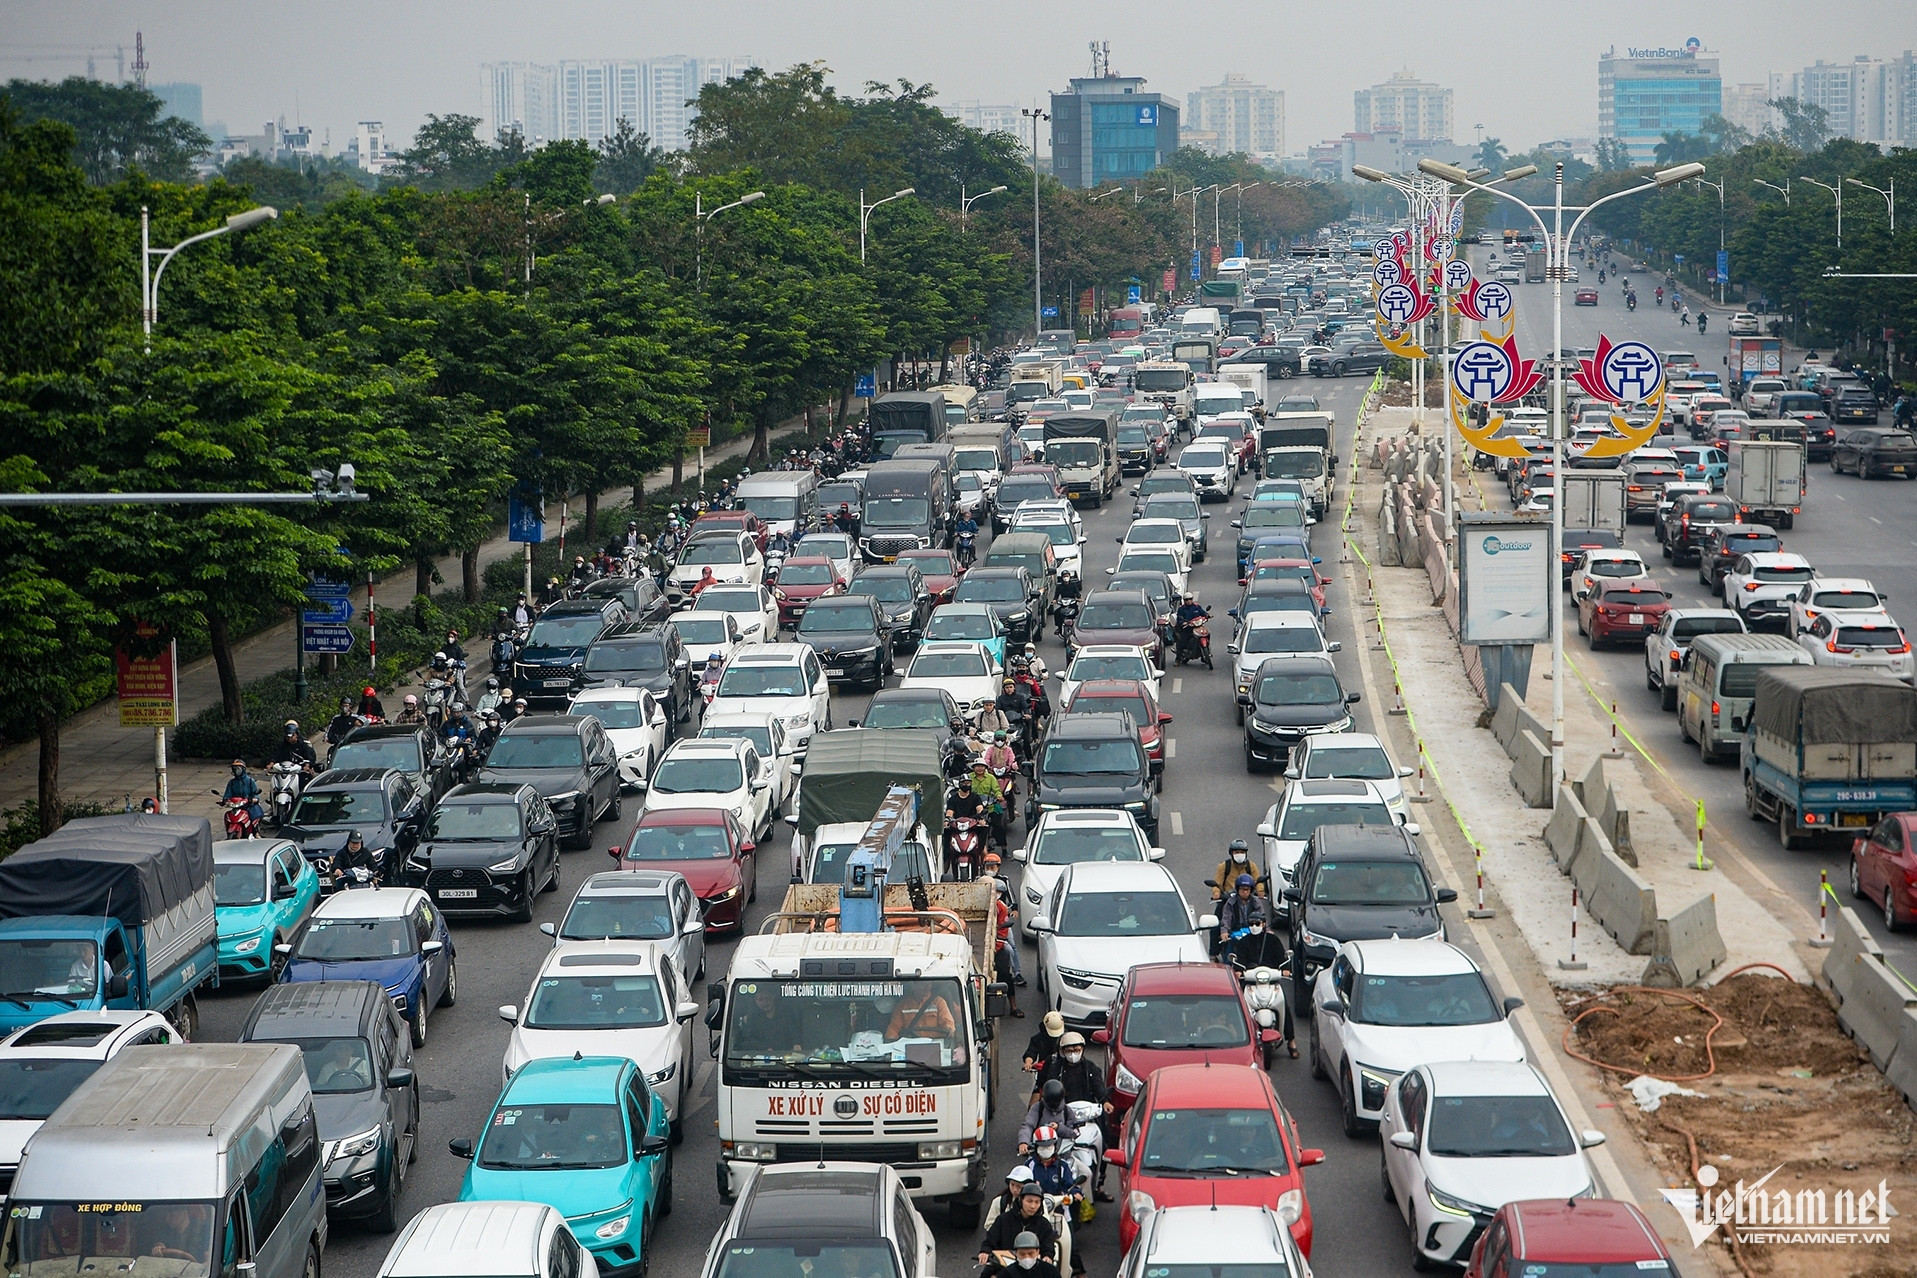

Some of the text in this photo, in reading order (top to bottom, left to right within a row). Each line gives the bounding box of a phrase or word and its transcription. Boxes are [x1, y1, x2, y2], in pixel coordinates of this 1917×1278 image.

[1628, 47, 1686, 58] VietinBank
[305, 637, 316, 646] VIỆT
[317, 637, 329, 646] NHẬT
[333, 637, 340, 645] HÀ
[341, 637, 349, 646] NỘI
[780, 982, 797, 997] TỔNG
[797, 982, 814, 997] CÔNG
[815, 985, 823, 997] TY
[823, 982, 837, 998] ĐIỆN
[870, 982, 883, 997] PHỐ
[883, 983, 892, 997] HÀ
[892, 983, 904, 997] NỘI
[768, 1080, 924, 1089] NISSAN DIESEL
[768, 1090, 824, 1116] XE XỬ LÝ
[863, 1090, 936, 1118] SỰ CỐ ĐIỆN
[77, 1202, 142, 1214] XE HỢP ĐỒNG
